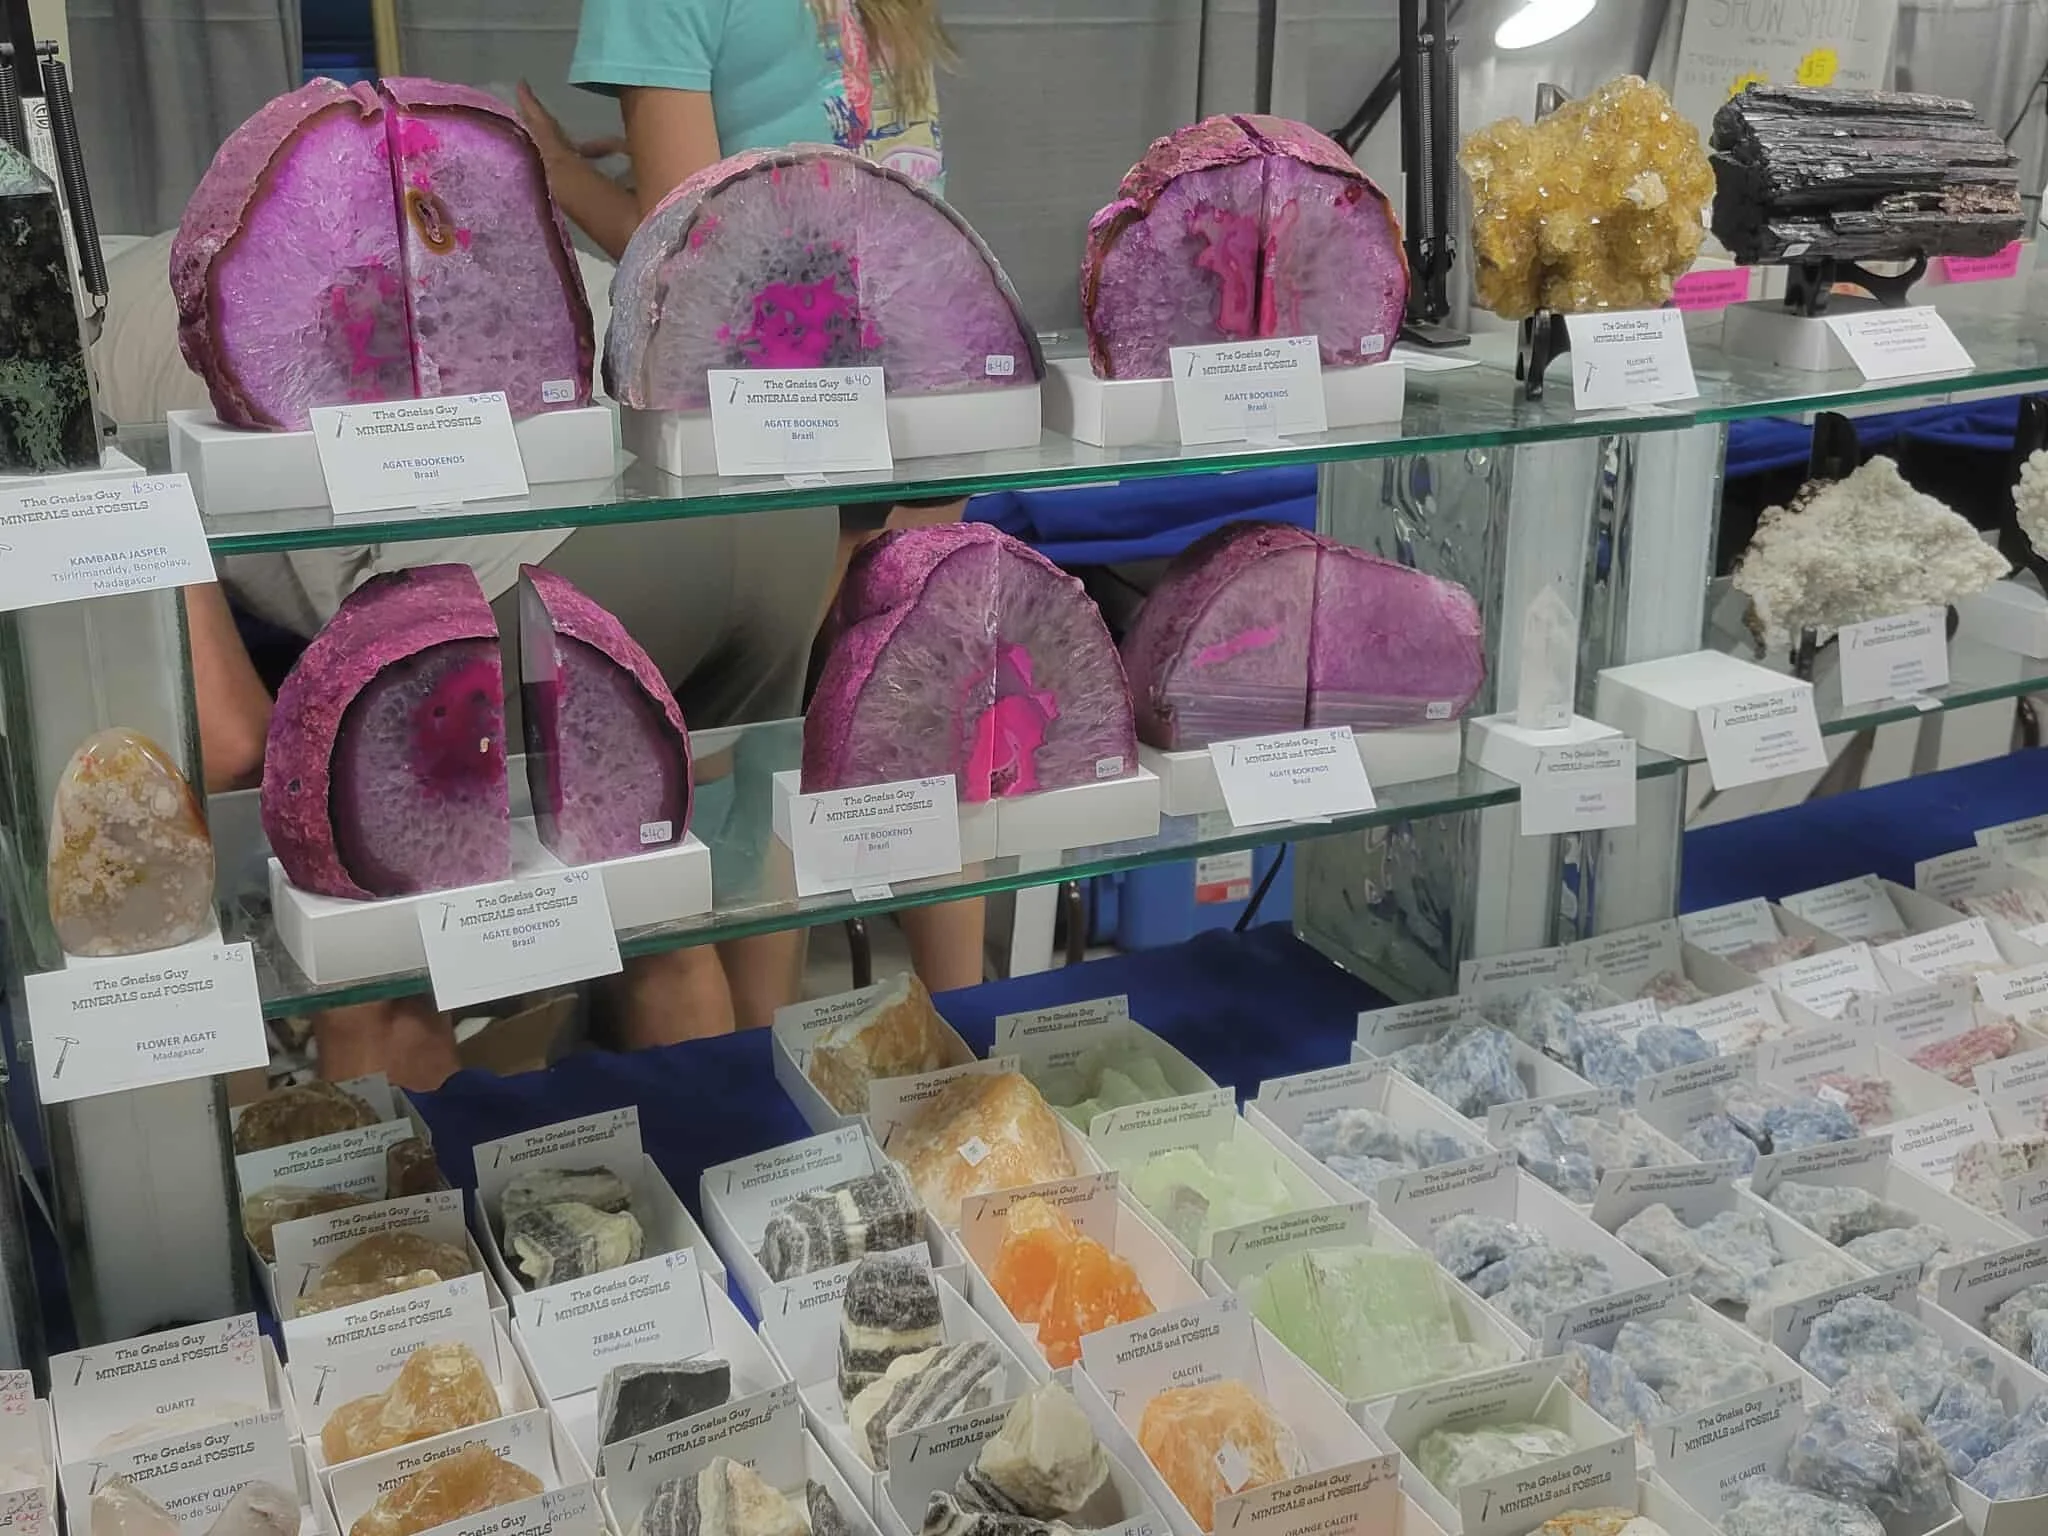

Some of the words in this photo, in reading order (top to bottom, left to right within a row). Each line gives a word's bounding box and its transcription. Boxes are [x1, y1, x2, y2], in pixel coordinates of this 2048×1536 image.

[764, 380, 785, 390] The
[788, 379, 817, 390] Gneiss
[819, 379, 839, 390] Guy
[747, 394, 799, 405] MINERALS
[801, 393, 817, 403] and
[819, 393, 858, 403] FOSSILS
[1225, 392, 1248, 401] AGATE
[373, 410, 395, 420] The
[397, 407, 434, 417] Gneiss
[436, 405, 458, 416] Guy
[764, 420, 791, 428] AGATE
[793, 419, 839, 428] BOOKENDS
[356, 422, 414, 436] MINERALS
[416, 420, 436, 430] and
[438, 416, 482, 429] FOSSILS
[792, 432, 814, 440] Brazil
[382, 460, 413, 470] AGATE
[414, 456, 465, 467] BOOKENDS
[414, 470, 439, 479] Brazil
[21, 498, 46, 508] The
[49, 493, 93, 505] Gneiss
[94, 490, 120, 501] Guy
[1, 509, 69, 526] MINERALS
[72, 506, 94, 517] and
[97, 501, 149, 514] FOSSILS
[70, 552, 127, 566] KAMBABA
[129, 547, 167, 560] JASPER
[94, 576, 156, 590] Madagascar
[843, 796, 862, 806] The
[864, 793, 894, 803] Gneiss
[896, 790, 915, 801] Guy
[826, 808, 876, 822] MINERALS
[877, 805, 894, 815] and
[896, 800, 933, 813] FOSSILS
[843, 832, 869, 842] AGATE
[871, 827, 913, 840] BOOKENDS
[476, 897, 497, 909] The
[499, 891, 534, 905] Gneiss
[535, 887, 556, 899] Guy
[460, 909, 515, 927] MINERALS
[516, 904, 535, 915] and
[535, 896, 578, 911] FOSSILS
[482, 928, 511, 941] AGATE
[512, 919, 561, 935] BOOKENDS
[512, 937, 535, 948] Brazil
[93, 978, 118, 991] The
[120, 973, 161, 987] Gneiss
[164, 968, 188, 983] Guy
[71, 991, 138, 1010] MINERALS
[140, 988, 161, 999] and
[164, 980, 213, 996] FOSSILS
[136, 1036, 181, 1051] FLOWER
[183, 1031, 216, 1043] AGATE
[153, 1046, 205, 1062] Madagascar
[666, 1254, 687, 1269] $5
[570, 1289, 591, 1301] The
[593, 1279, 628, 1295] Gneiss
[629, 1274, 649, 1286] Guy
[345, 1314, 367, 1326] The
[369, 1305, 407, 1320] Gneiss
[409, 1298, 431, 1312] Guy
[555, 1301, 609, 1322] MINERALS
[611, 1295, 629, 1306] and
[631, 1282, 670, 1301] FOSSILS
[327, 1325, 386, 1346] MINERALS
[388, 1319, 407, 1331] and
[408, 1307, 452, 1326] FOSSILS
[592, 1330, 621, 1345] ZEBRA
[623, 1321, 656, 1336] CALCITE
[1130, 1332, 1148, 1343] The
[1150, 1322, 1179, 1336] Gneiss
[1181, 1316, 1200, 1329] Guy
[115, 1349, 138, 1361] The
[141, 1340, 179, 1355] Gneiss
[182, 1335, 206, 1347] Guy
[1117, 1343, 1163, 1363] MINERALS
[1165, 1339, 1181, 1350] and
[1182, 1325, 1220, 1342] FOSSILS
[96, 1360, 157, 1381] MINERALS
[159, 1355, 180, 1367] and
[182, 1344, 228, 1362] FOSSILS
[1172, 1364, 1203, 1380] CALCITE
[156, 1399, 196, 1414] QUARTZ
[1697, 1418, 1714, 1431] The
[1744, 1400, 1763, 1415] Guy
[666, 1431, 689, 1443] The
[691, 1417, 727, 1433] Gneiss
[729, 1408, 751, 1421] Guy
[948, 1423, 969, 1436] The
[971, 1413, 1005, 1430] Gneiss
[1684, 1428, 1729, 1452] MINERALS
[1730, 1421, 1745, 1434] and
[1745, 1410, 1780, 1429] FOSSILS
[133, 1452, 157, 1466] The
[161, 1441, 202, 1459] Gneiss
[204, 1433, 230, 1447] Guy
[648, 1436, 706, 1464] MINERALS
[708, 1431, 727, 1443] and
[728, 1412, 771, 1435] FOSSILS
[928, 1432, 983, 1456] MINERALS
[180, 1459, 203, 1470] and
[205, 1442, 255, 1464] FOSSILS
[397, 1457, 421, 1472] The
[422, 1445, 461, 1464] Gneiss
[1271, 1488, 1294, 1501] The
[1296, 1482, 1326, 1496] Gneiss
[1329, 1474, 1352, 1486] Guy
[1516, 1481, 1535, 1494] The
[1537, 1471, 1570, 1488] Gneiss
[1572, 1462, 1593, 1476] Guy
[165, 1491, 209, 1510] SMOKEY
[1250, 1501, 1305, 1522] MINERALS
[1308, 1496, 1325, 1507] and
[1326, 1484, 1369, 1501] FOSSILS
[1499, 1493, 1551, 1517] MINERALS
[1553, 1486, 1570, 1500] and
[1572, 1472, 1612, 1494] FOSSILS
[1324, 1513, 1359, 1529] CALCITE
